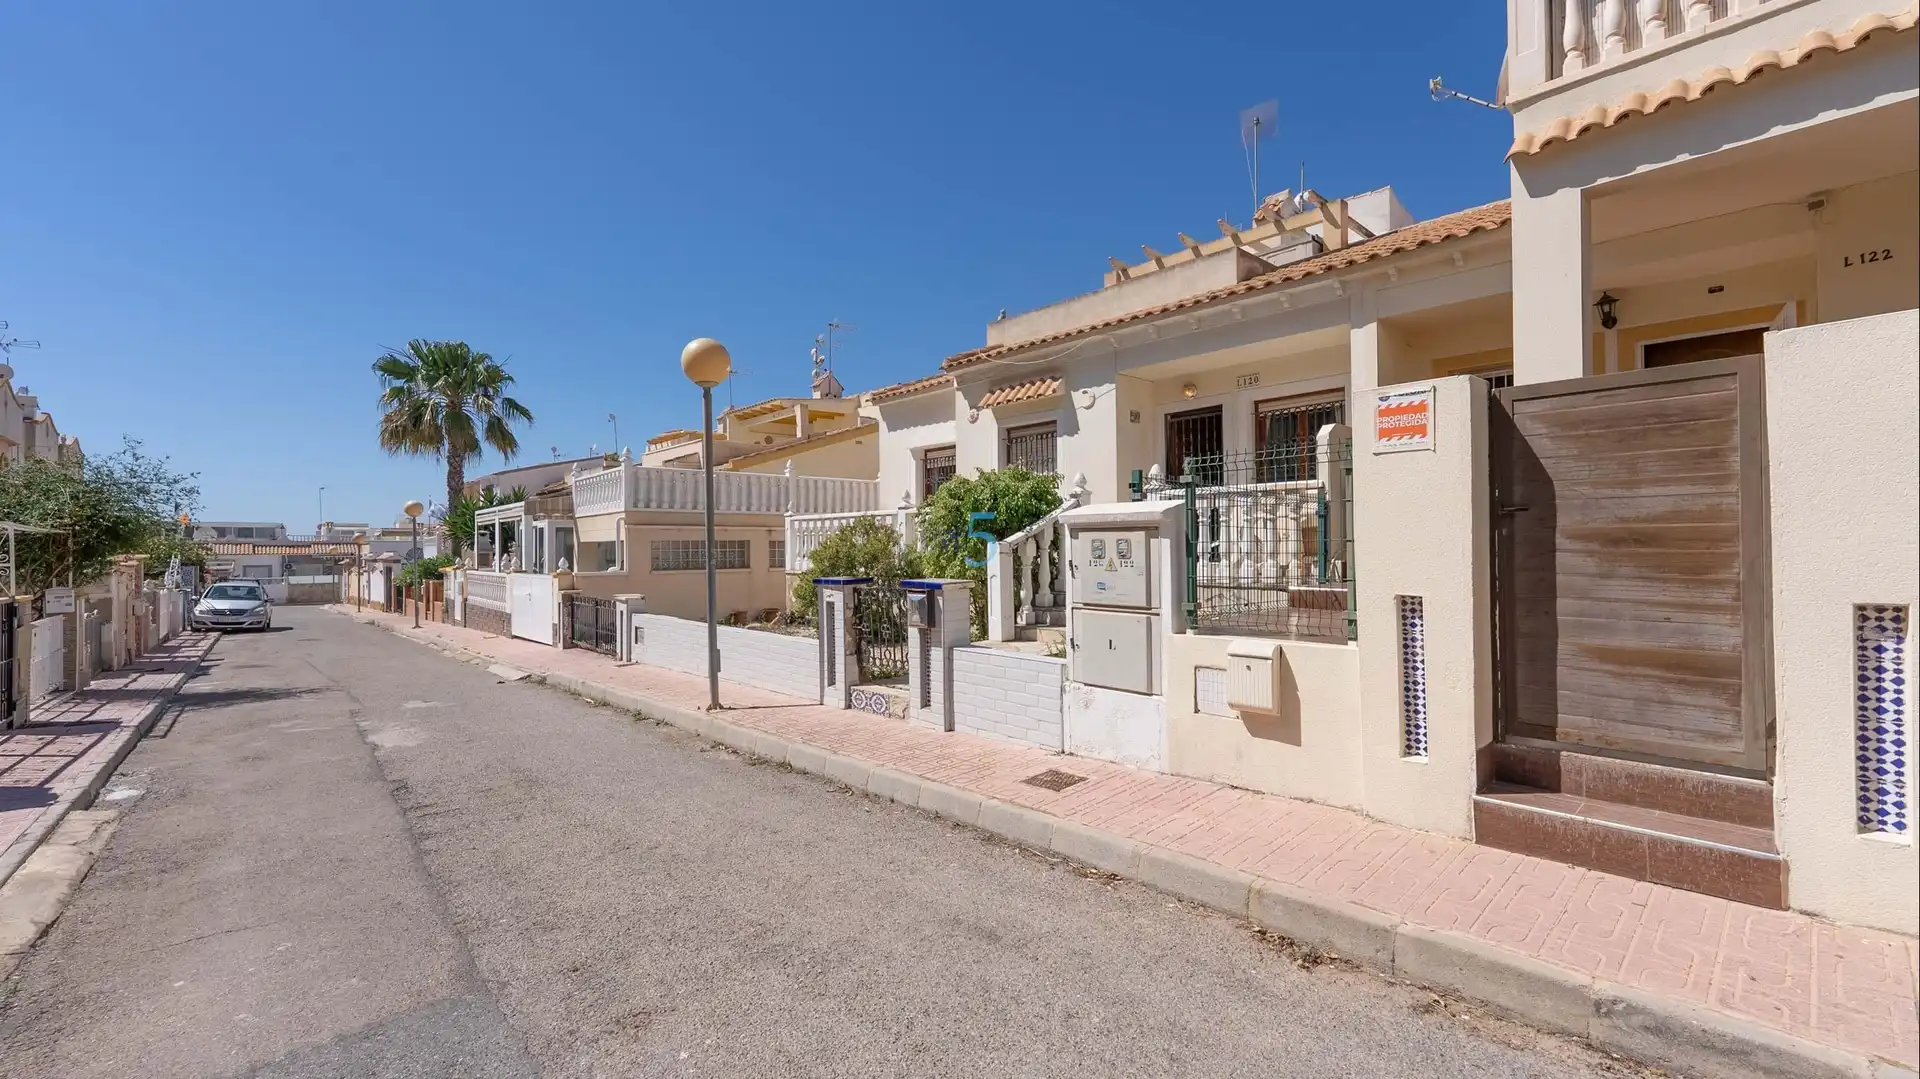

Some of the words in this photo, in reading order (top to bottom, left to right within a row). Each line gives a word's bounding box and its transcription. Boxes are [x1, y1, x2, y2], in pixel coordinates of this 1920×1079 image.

[1843, 256, 1854, 268] L
[1859, 248, 1893, 264] 122
[1376, 412, 1428, 424] PROPIEDAD
[1376, 418, 1428, 429] PROTEGIDA
